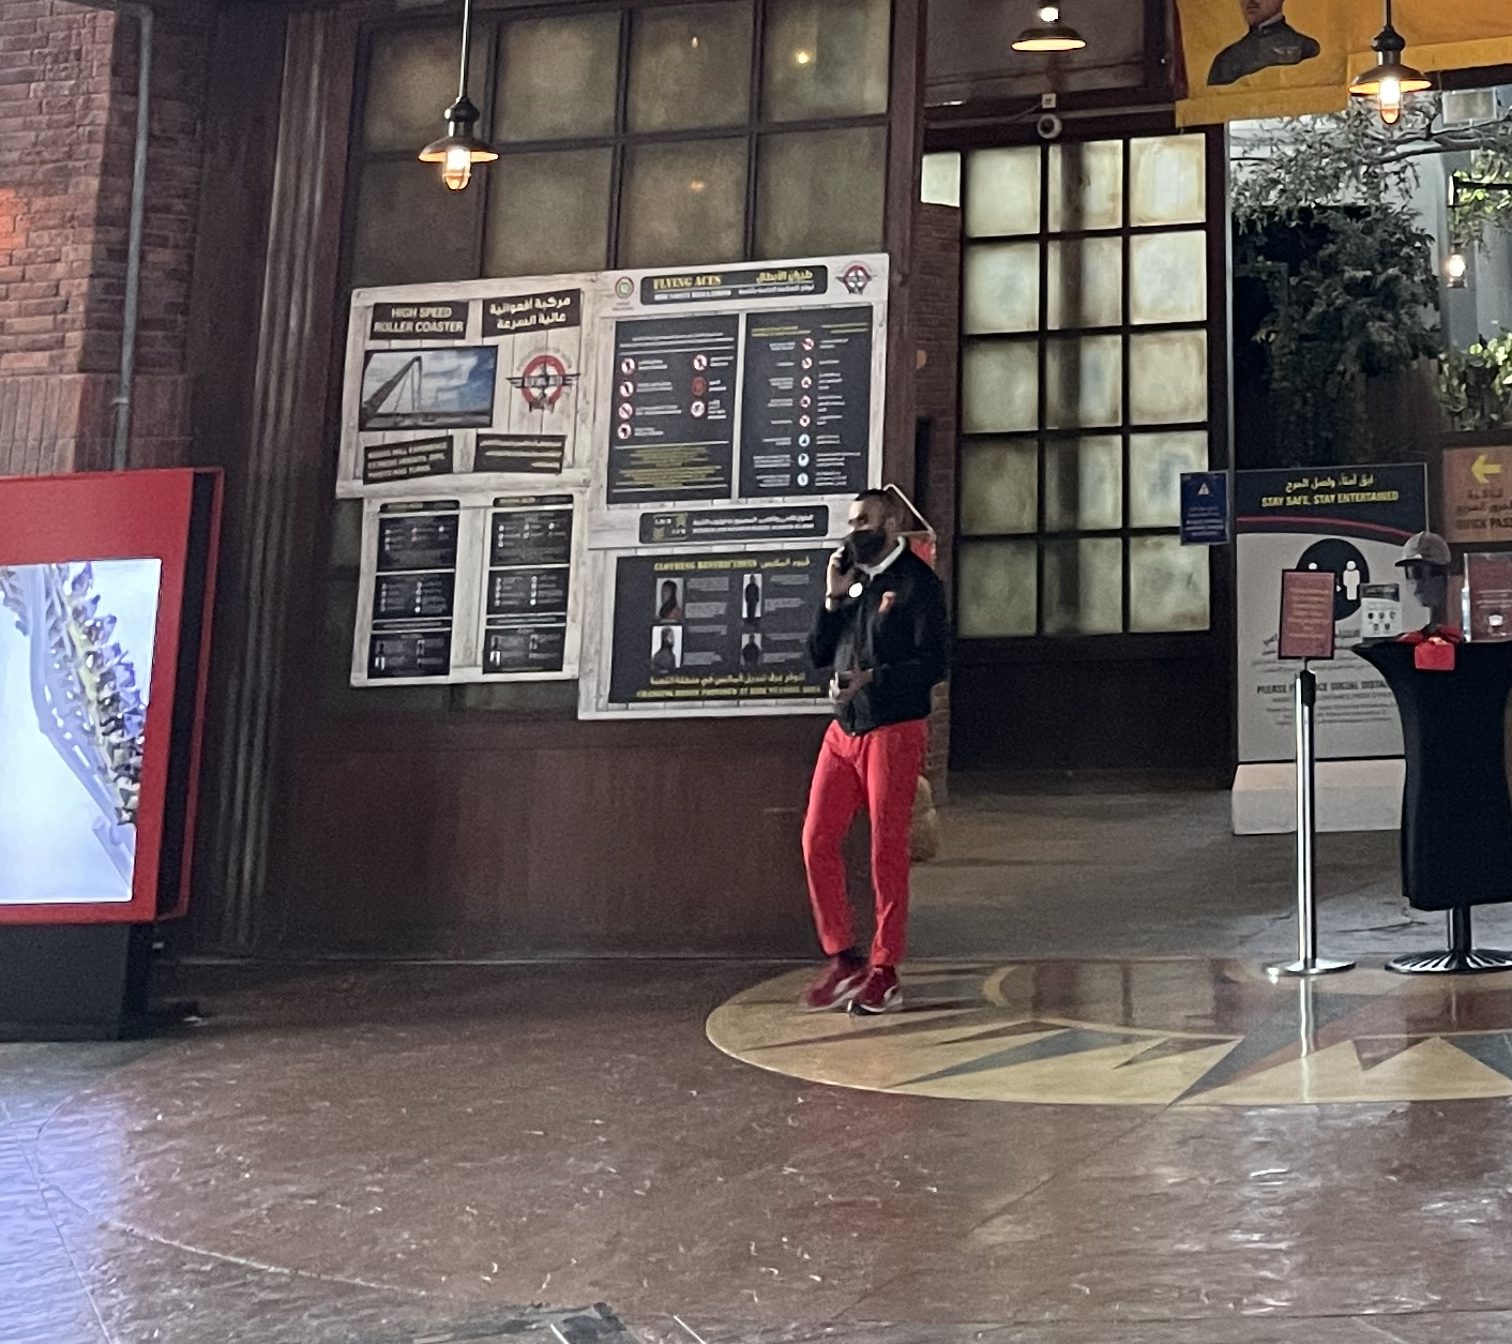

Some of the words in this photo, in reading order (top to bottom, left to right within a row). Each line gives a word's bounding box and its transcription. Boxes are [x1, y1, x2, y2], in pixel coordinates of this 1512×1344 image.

[653, 276, 692, 290] FLYING
[694, 275, 721, 287] ACES
[391, 307, 417, 318] HIGH
[419, 307, 452, 318] SPEED
[374, 321, 413, 333] ROLLER
[415, 320, 464, 333] COASTER
[1261, 496, 1285, 507] STAY
[1313, 494, 1335, 505] STAY
[1337, 491, 1399, 504] ENTERTAINED
